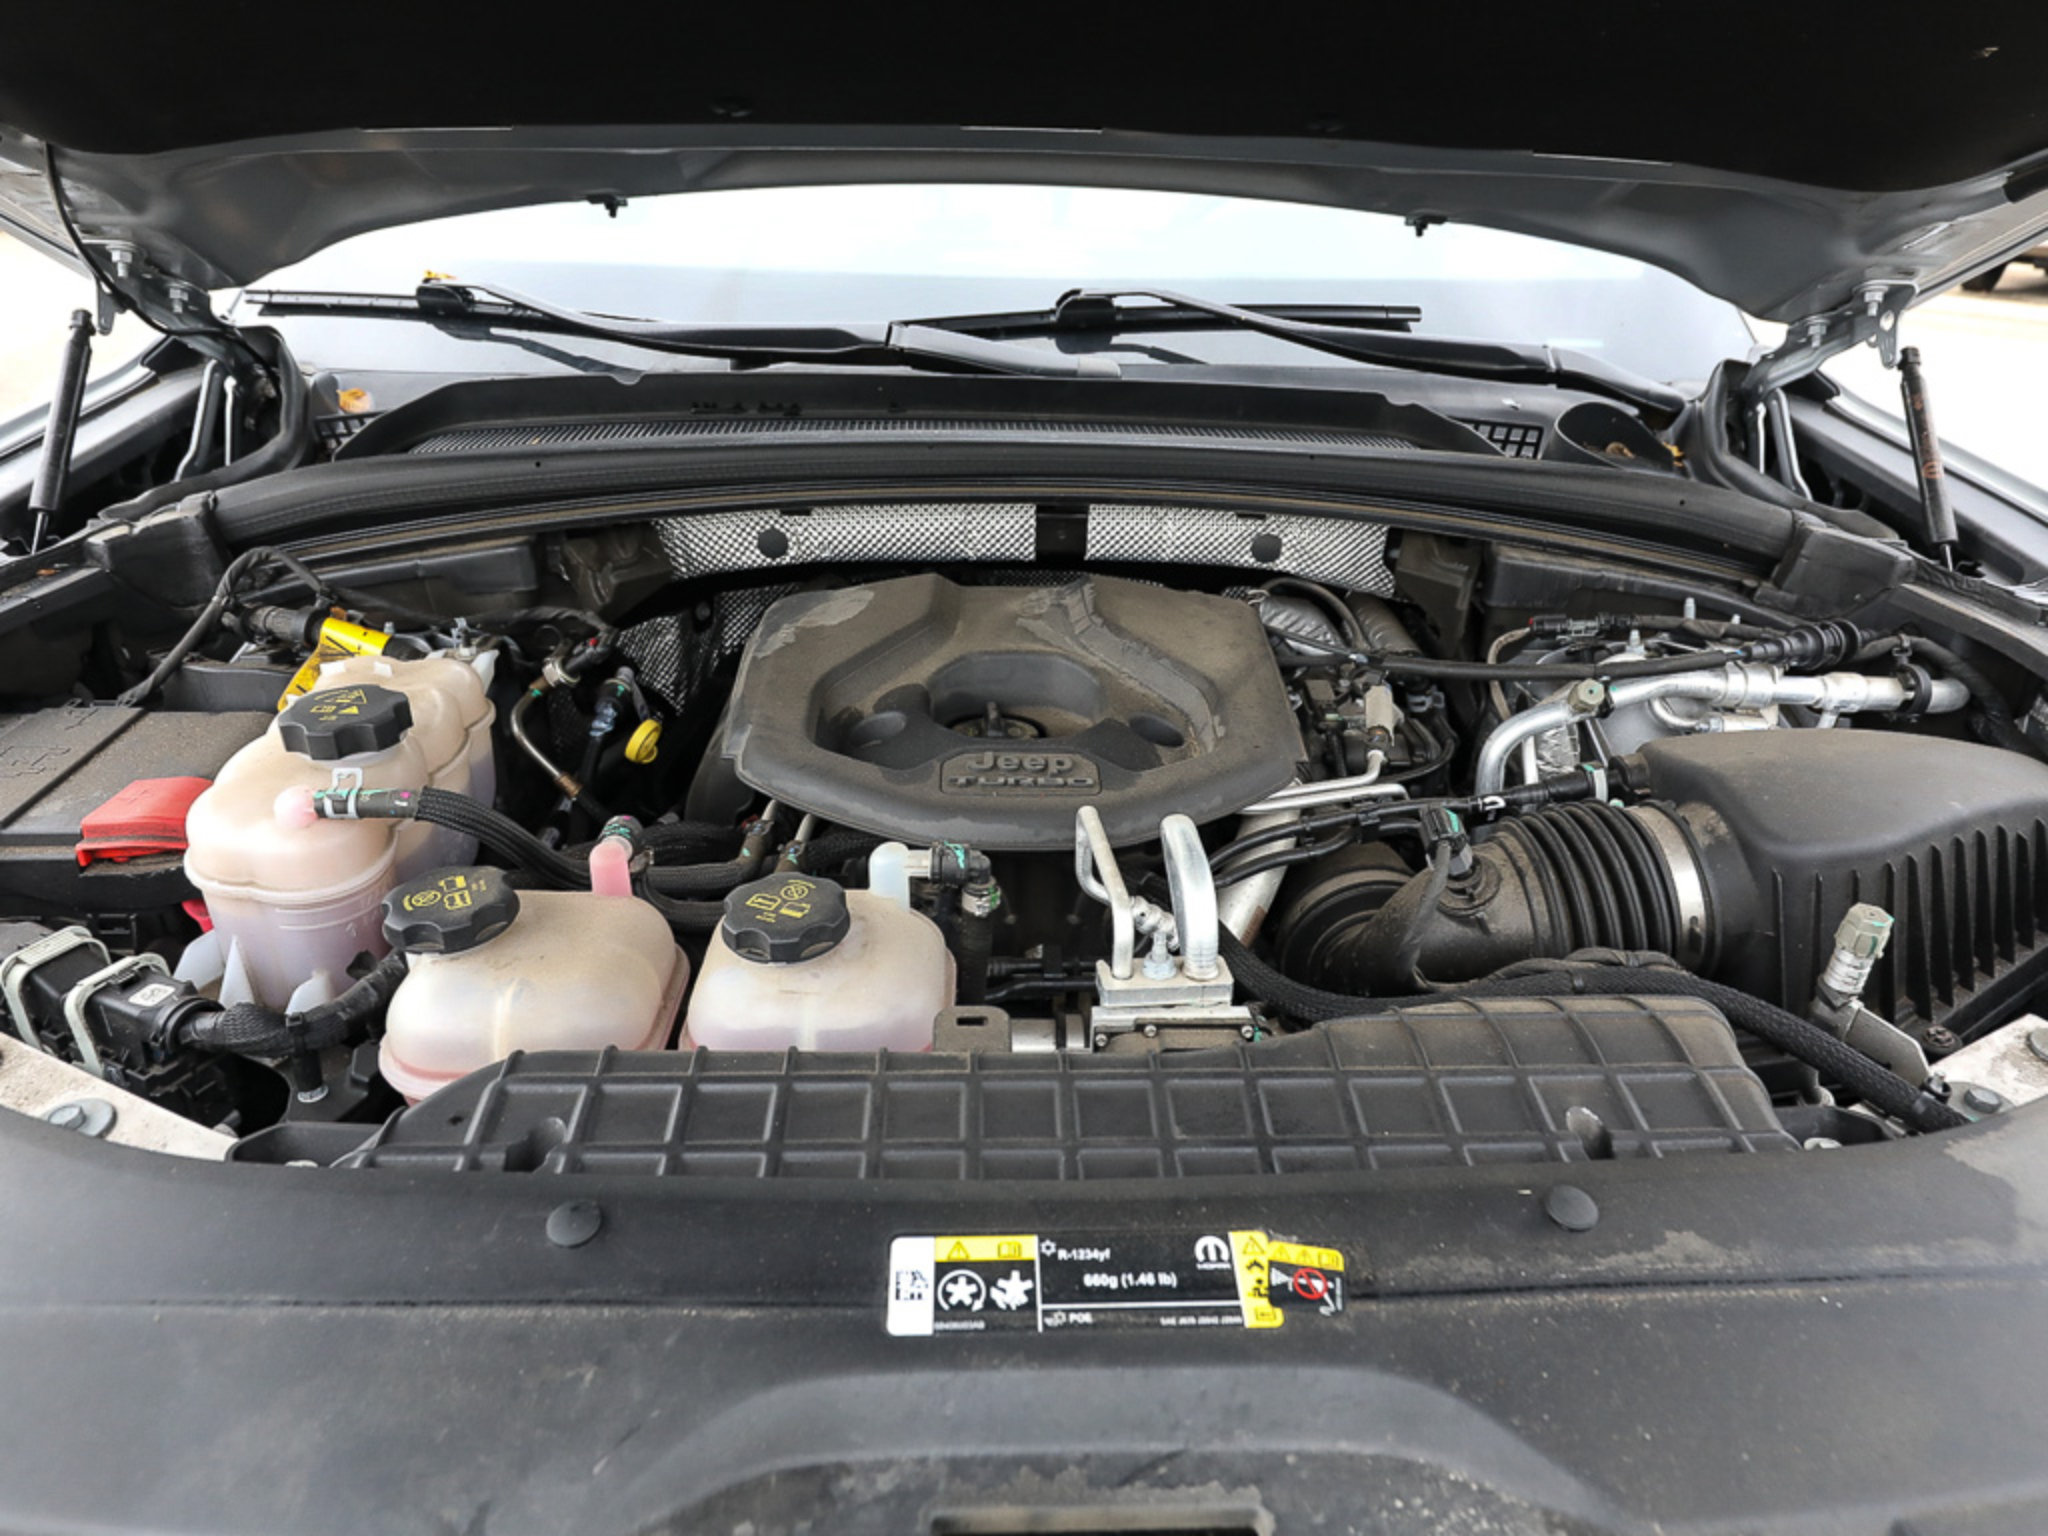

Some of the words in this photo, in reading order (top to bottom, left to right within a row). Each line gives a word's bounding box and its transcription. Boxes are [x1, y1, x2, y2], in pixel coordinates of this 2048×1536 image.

[966, 750, 1075, 777] Jeep
[947, 775, 1096, 788] TURBO
[1057, 1247, 1111, 1263] R-1234yf
[1157, 1271, 1178, 1289] lb)
